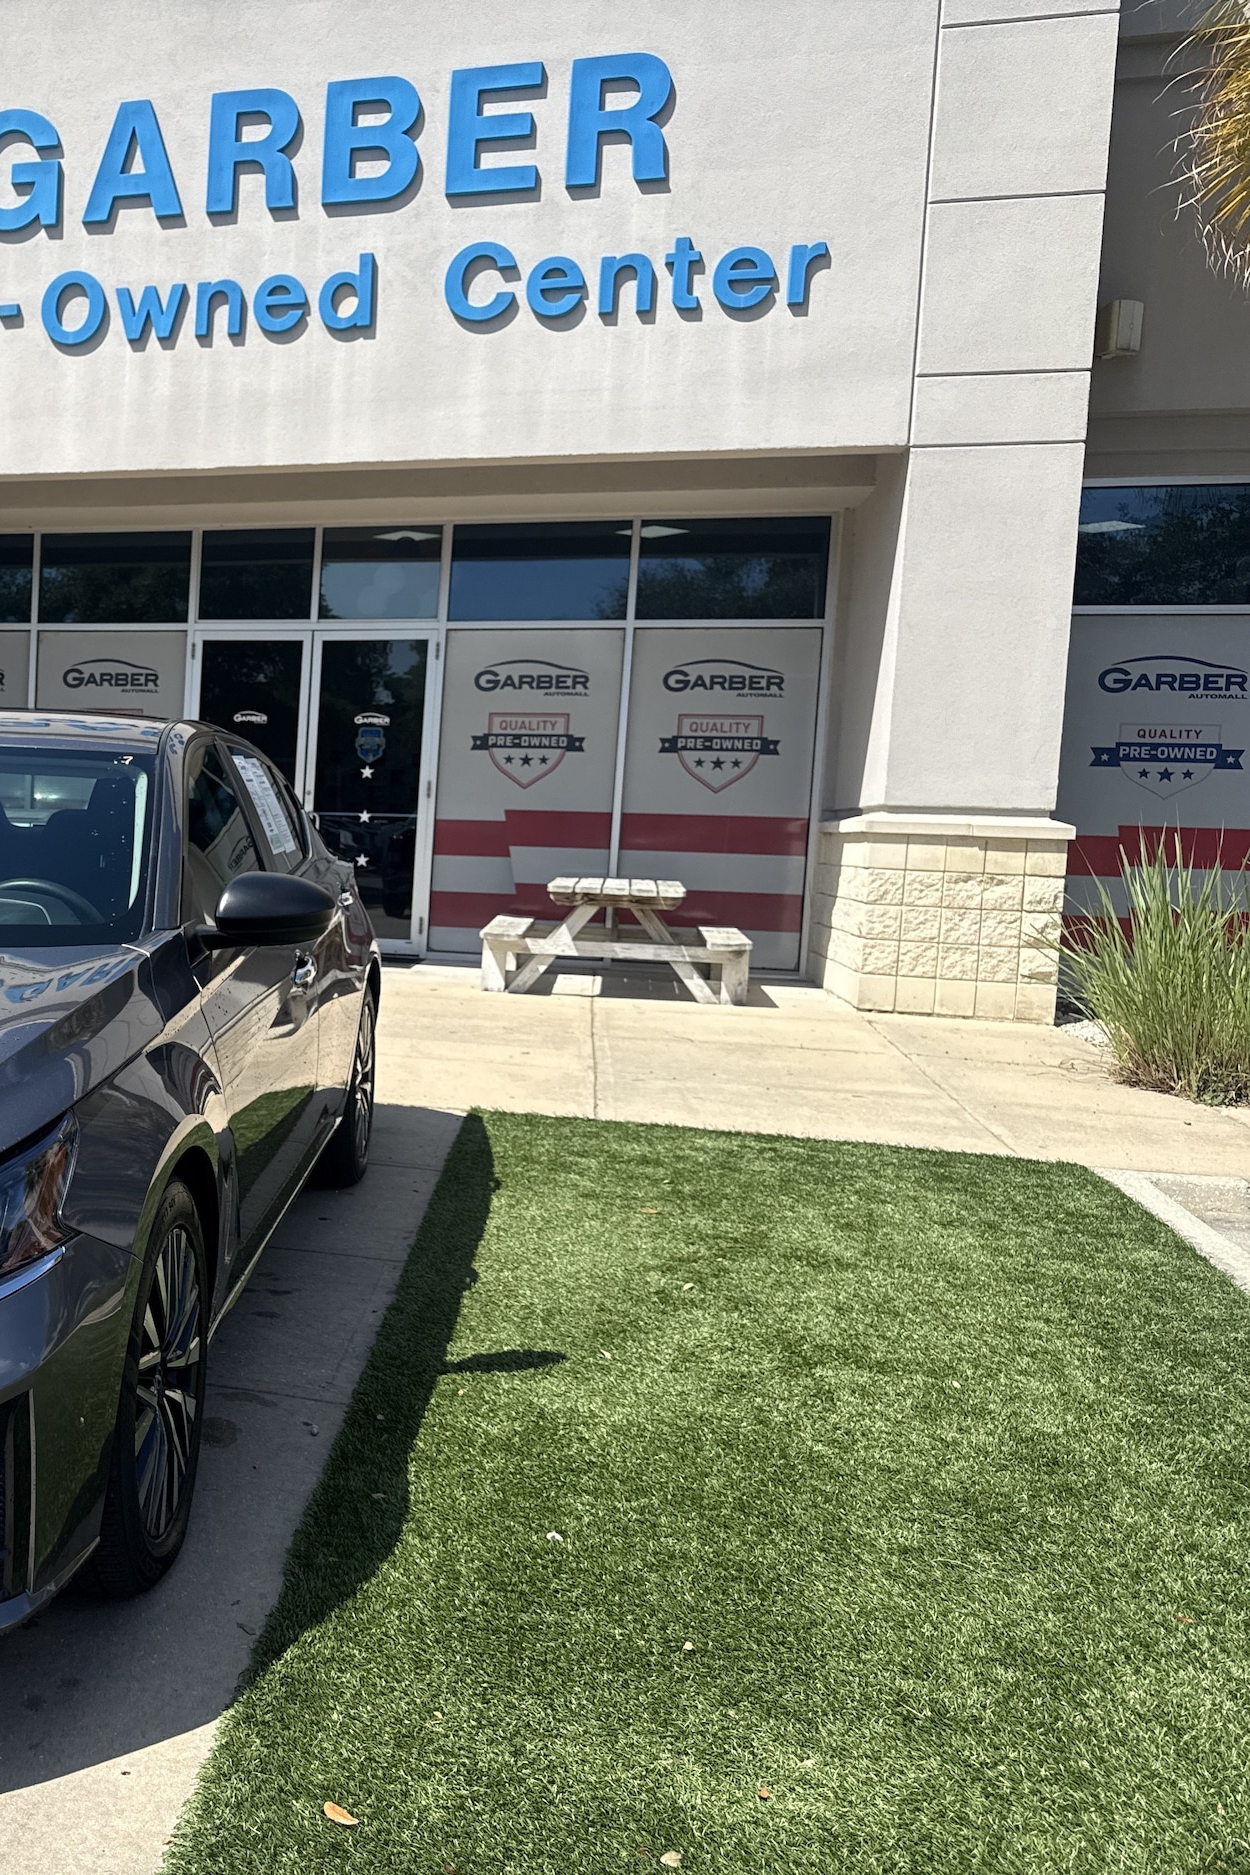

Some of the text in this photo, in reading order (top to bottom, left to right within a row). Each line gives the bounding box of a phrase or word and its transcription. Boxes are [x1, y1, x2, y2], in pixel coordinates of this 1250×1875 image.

[445, 237, 829, 325] Center
[62, 668, 160, 688] GARBER
[474, 669, 589, 692] GARBER
[663, 669, 785, 693] GARBER
[1098, 667, 1248, 693] GARBER
[499, 719, 558, 732] QUALITY
[688, 721, 751, 734] QUALITY
[1137, 728, 1203, 739] QUALITY
[488, 735, 568, 748] PRE-OWNED
[676, 737, 762, 751] PRE-OWNED
[1118, 746, 1217, 760] PRE-OWNED
